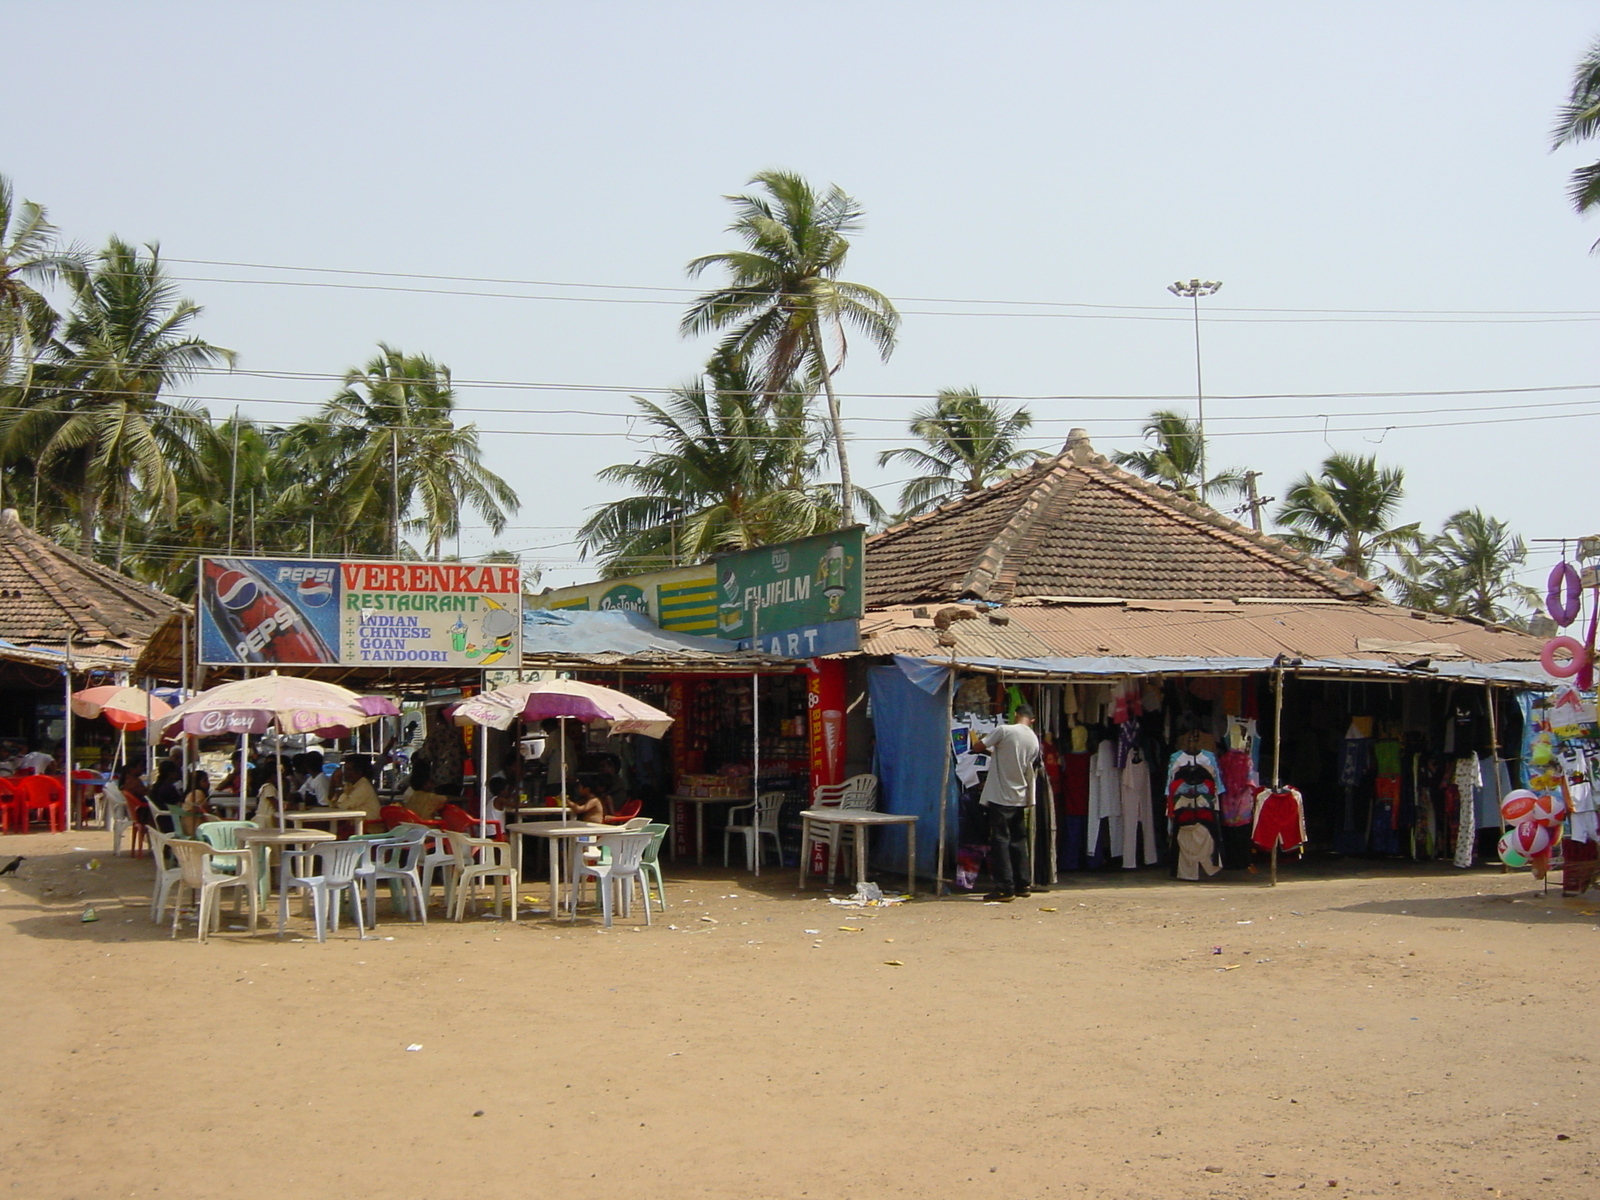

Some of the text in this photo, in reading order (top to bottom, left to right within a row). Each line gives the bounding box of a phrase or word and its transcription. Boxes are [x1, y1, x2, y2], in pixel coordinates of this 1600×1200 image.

[277, 567, 335, 583] PEPSI
[341, 563, 520, 594] VERENKAR
[744, 575, 811, 611] FUJIFILM
[346, 594, 480, 613] RESTAURANT
[359, 615, 419, 627] INDIAN
[235, 605, 303, 663] PEPSI
[359, 627, 432, 639] CHINESE
[360, 639, 406, 650] GOAN
[360, 650, 449, 662] TANDOORI
[200, 711, 256, 733] Cadbury
